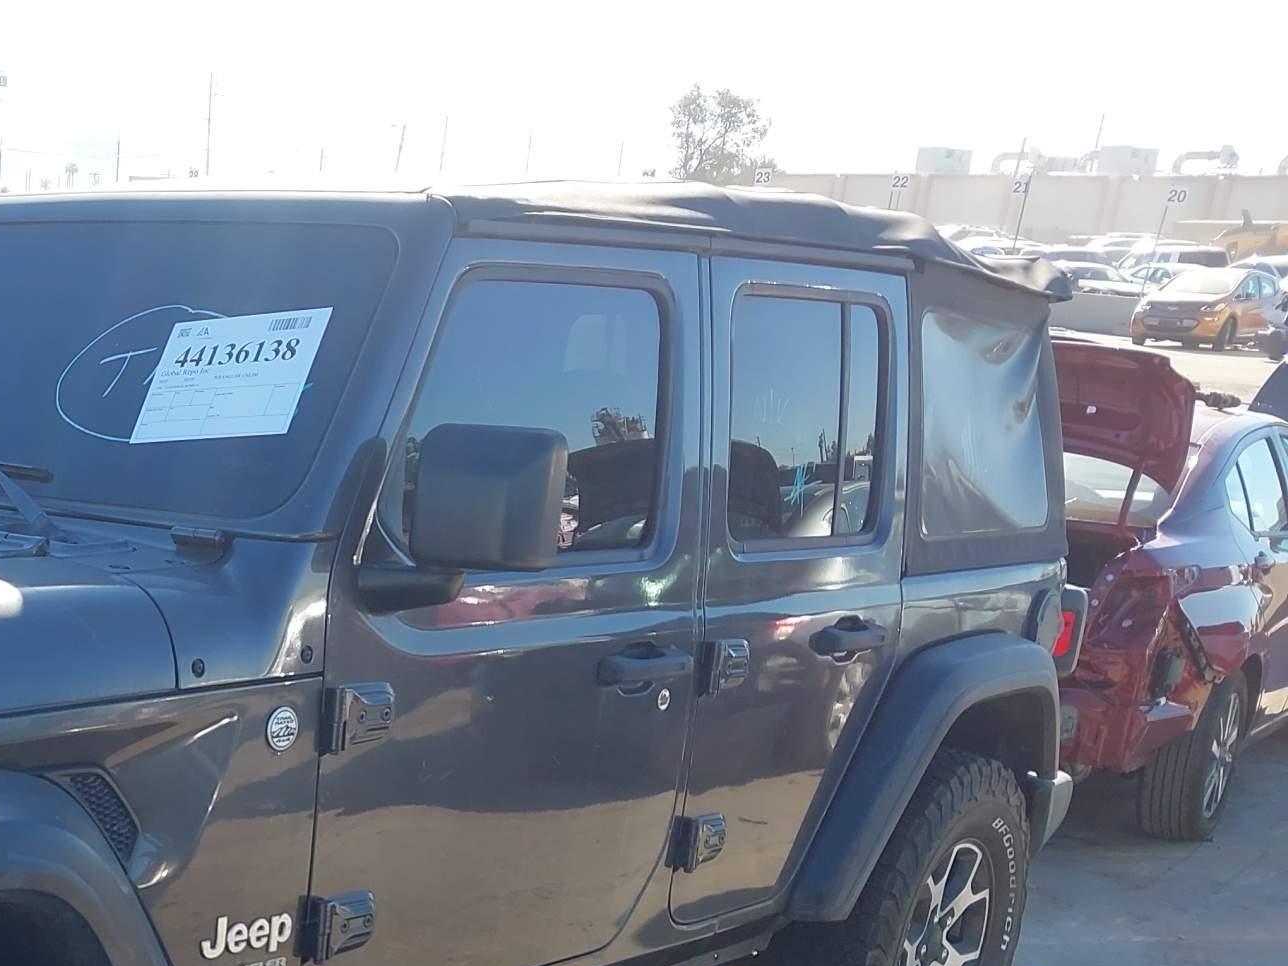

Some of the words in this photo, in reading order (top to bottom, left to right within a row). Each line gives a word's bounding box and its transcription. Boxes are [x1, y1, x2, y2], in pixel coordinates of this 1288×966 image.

[755, 171, 770, 184] 23
[892, 175, 909, 188] 22
[1012, 180, 1030, 193] 21
[1167, 189, 1187, 203] 20
[174, 338, 300, 368] 44136138
[100, 347, 158, 397] T
[200, 912, 292, 960] Jeep
